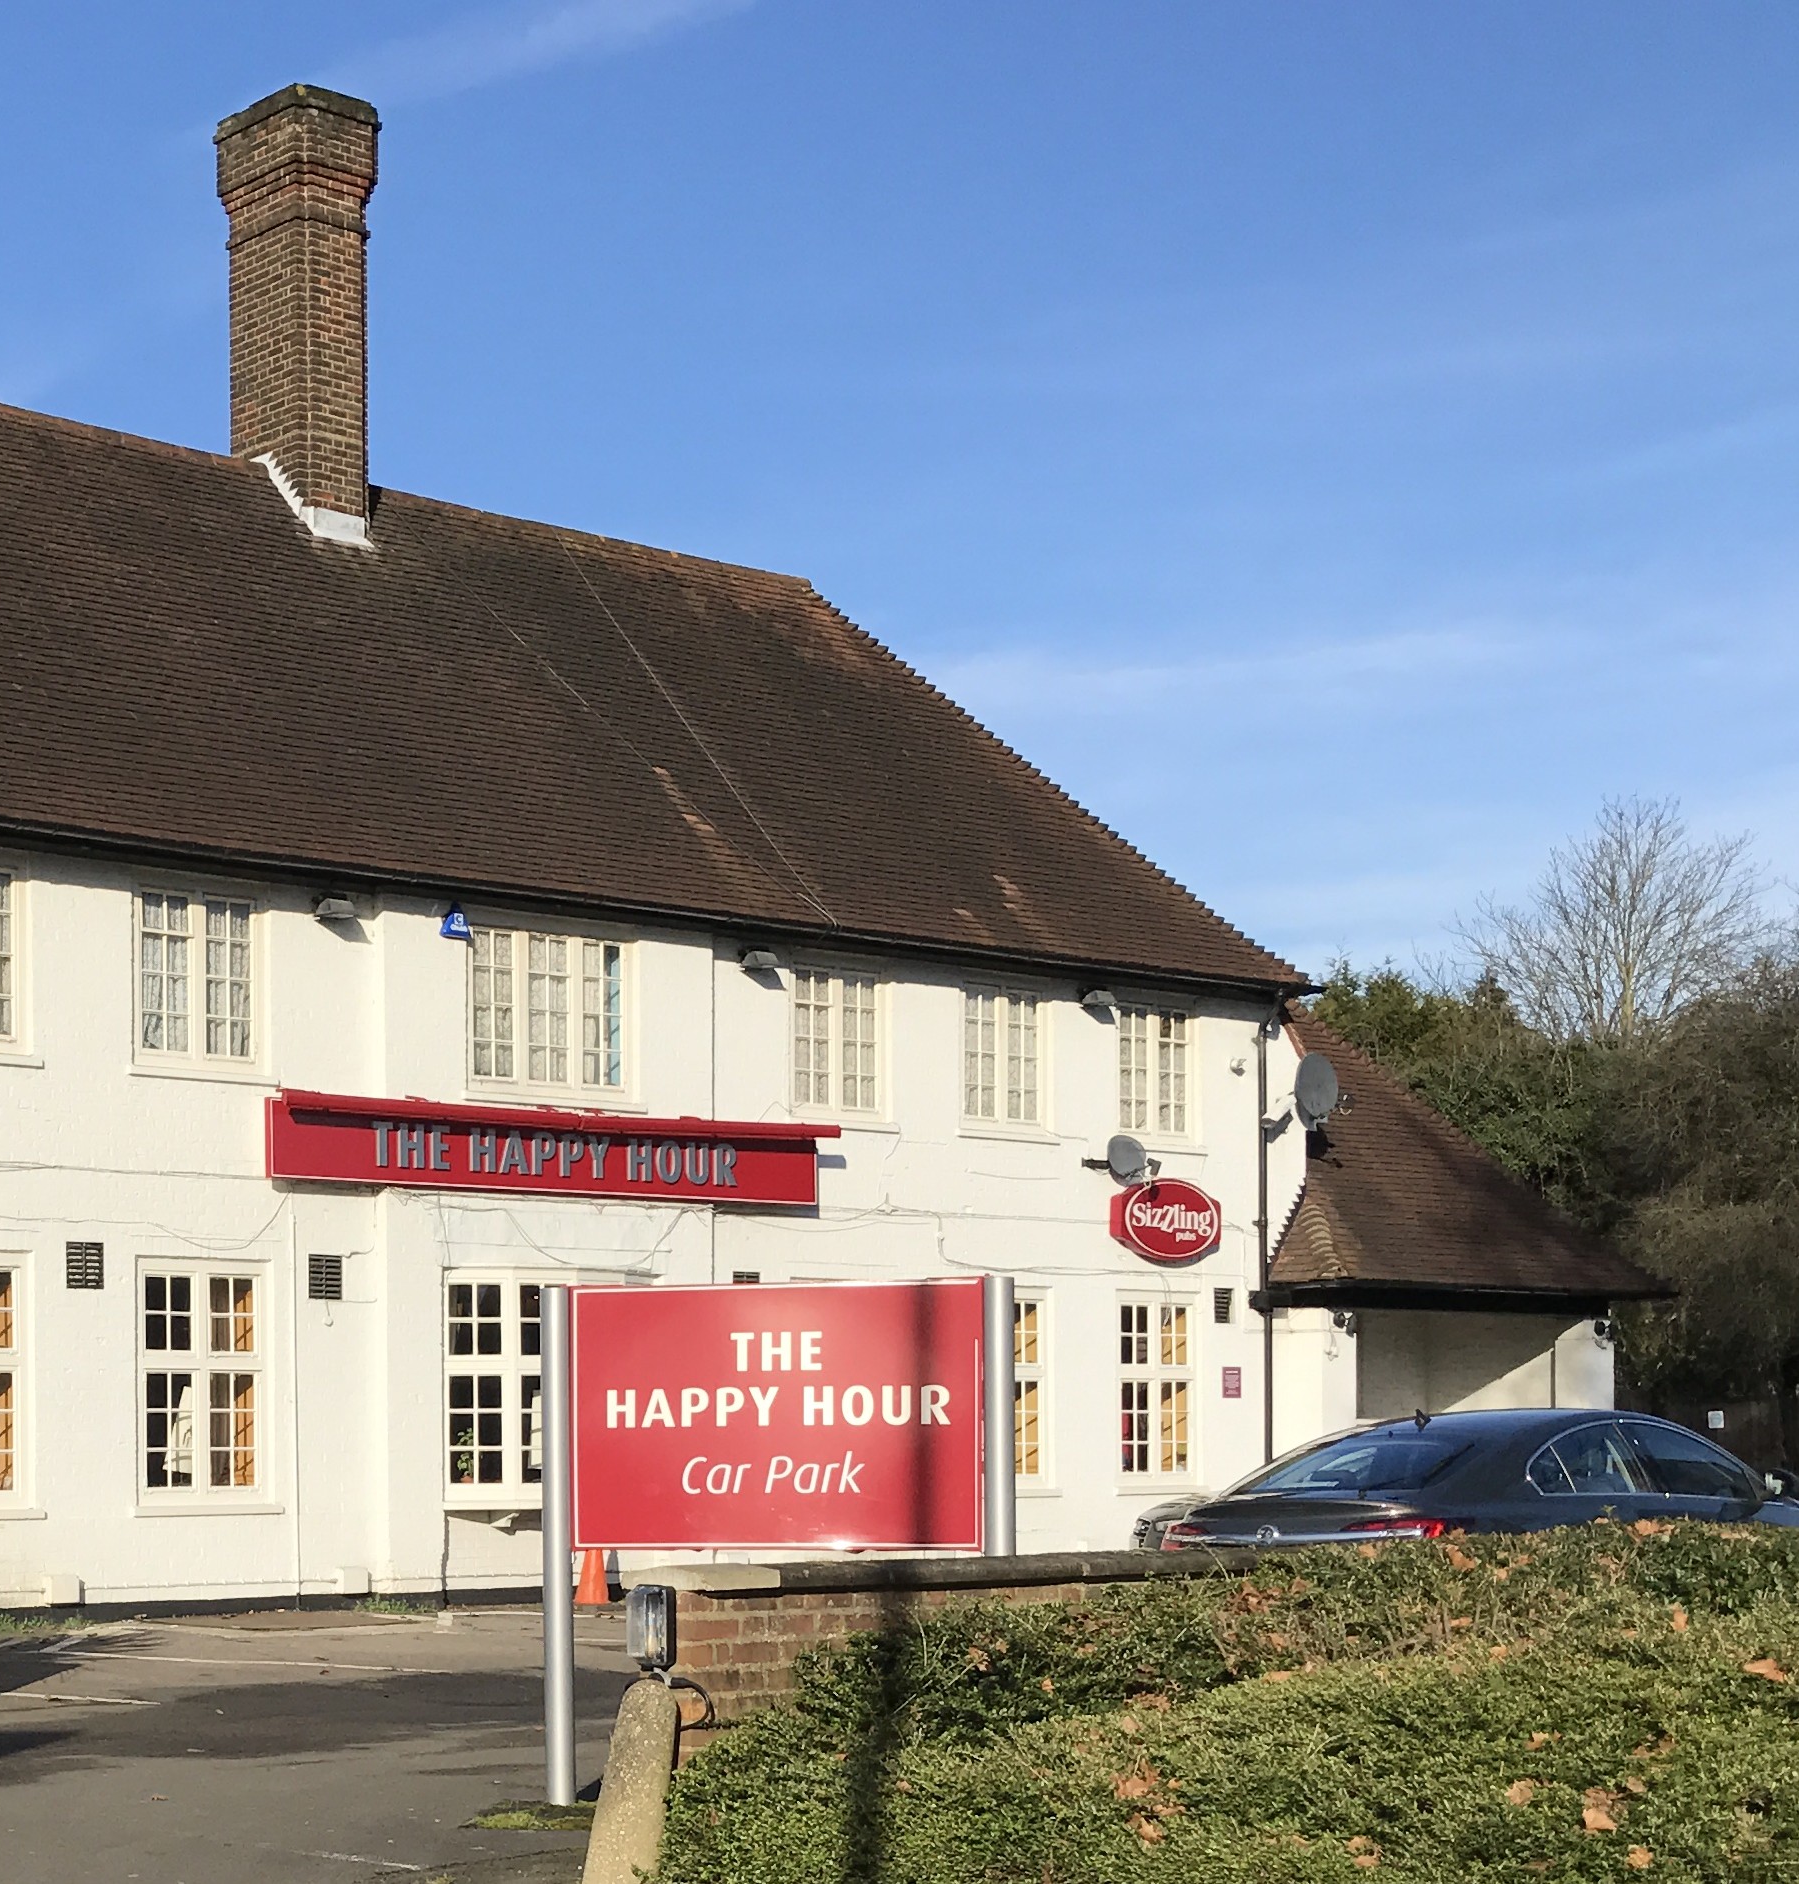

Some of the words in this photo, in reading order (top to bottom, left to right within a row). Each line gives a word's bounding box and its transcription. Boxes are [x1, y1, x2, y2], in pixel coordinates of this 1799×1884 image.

[372, 1120, 451, 1171] THE
[468, 1126, 611, 1180] HAPPY
[626, 1137, 739, 1187] HOUR
[1175, 1230, 1197, 1242] pubs
[729, 1331, 823, 1372] THE
[605, 1386, 780, 1429] HAPPY
[802, 1384, 952, 1427] HOUR
[681, 1456, 752, 1495] Car
[764, 1451, 867, 1495] Park
